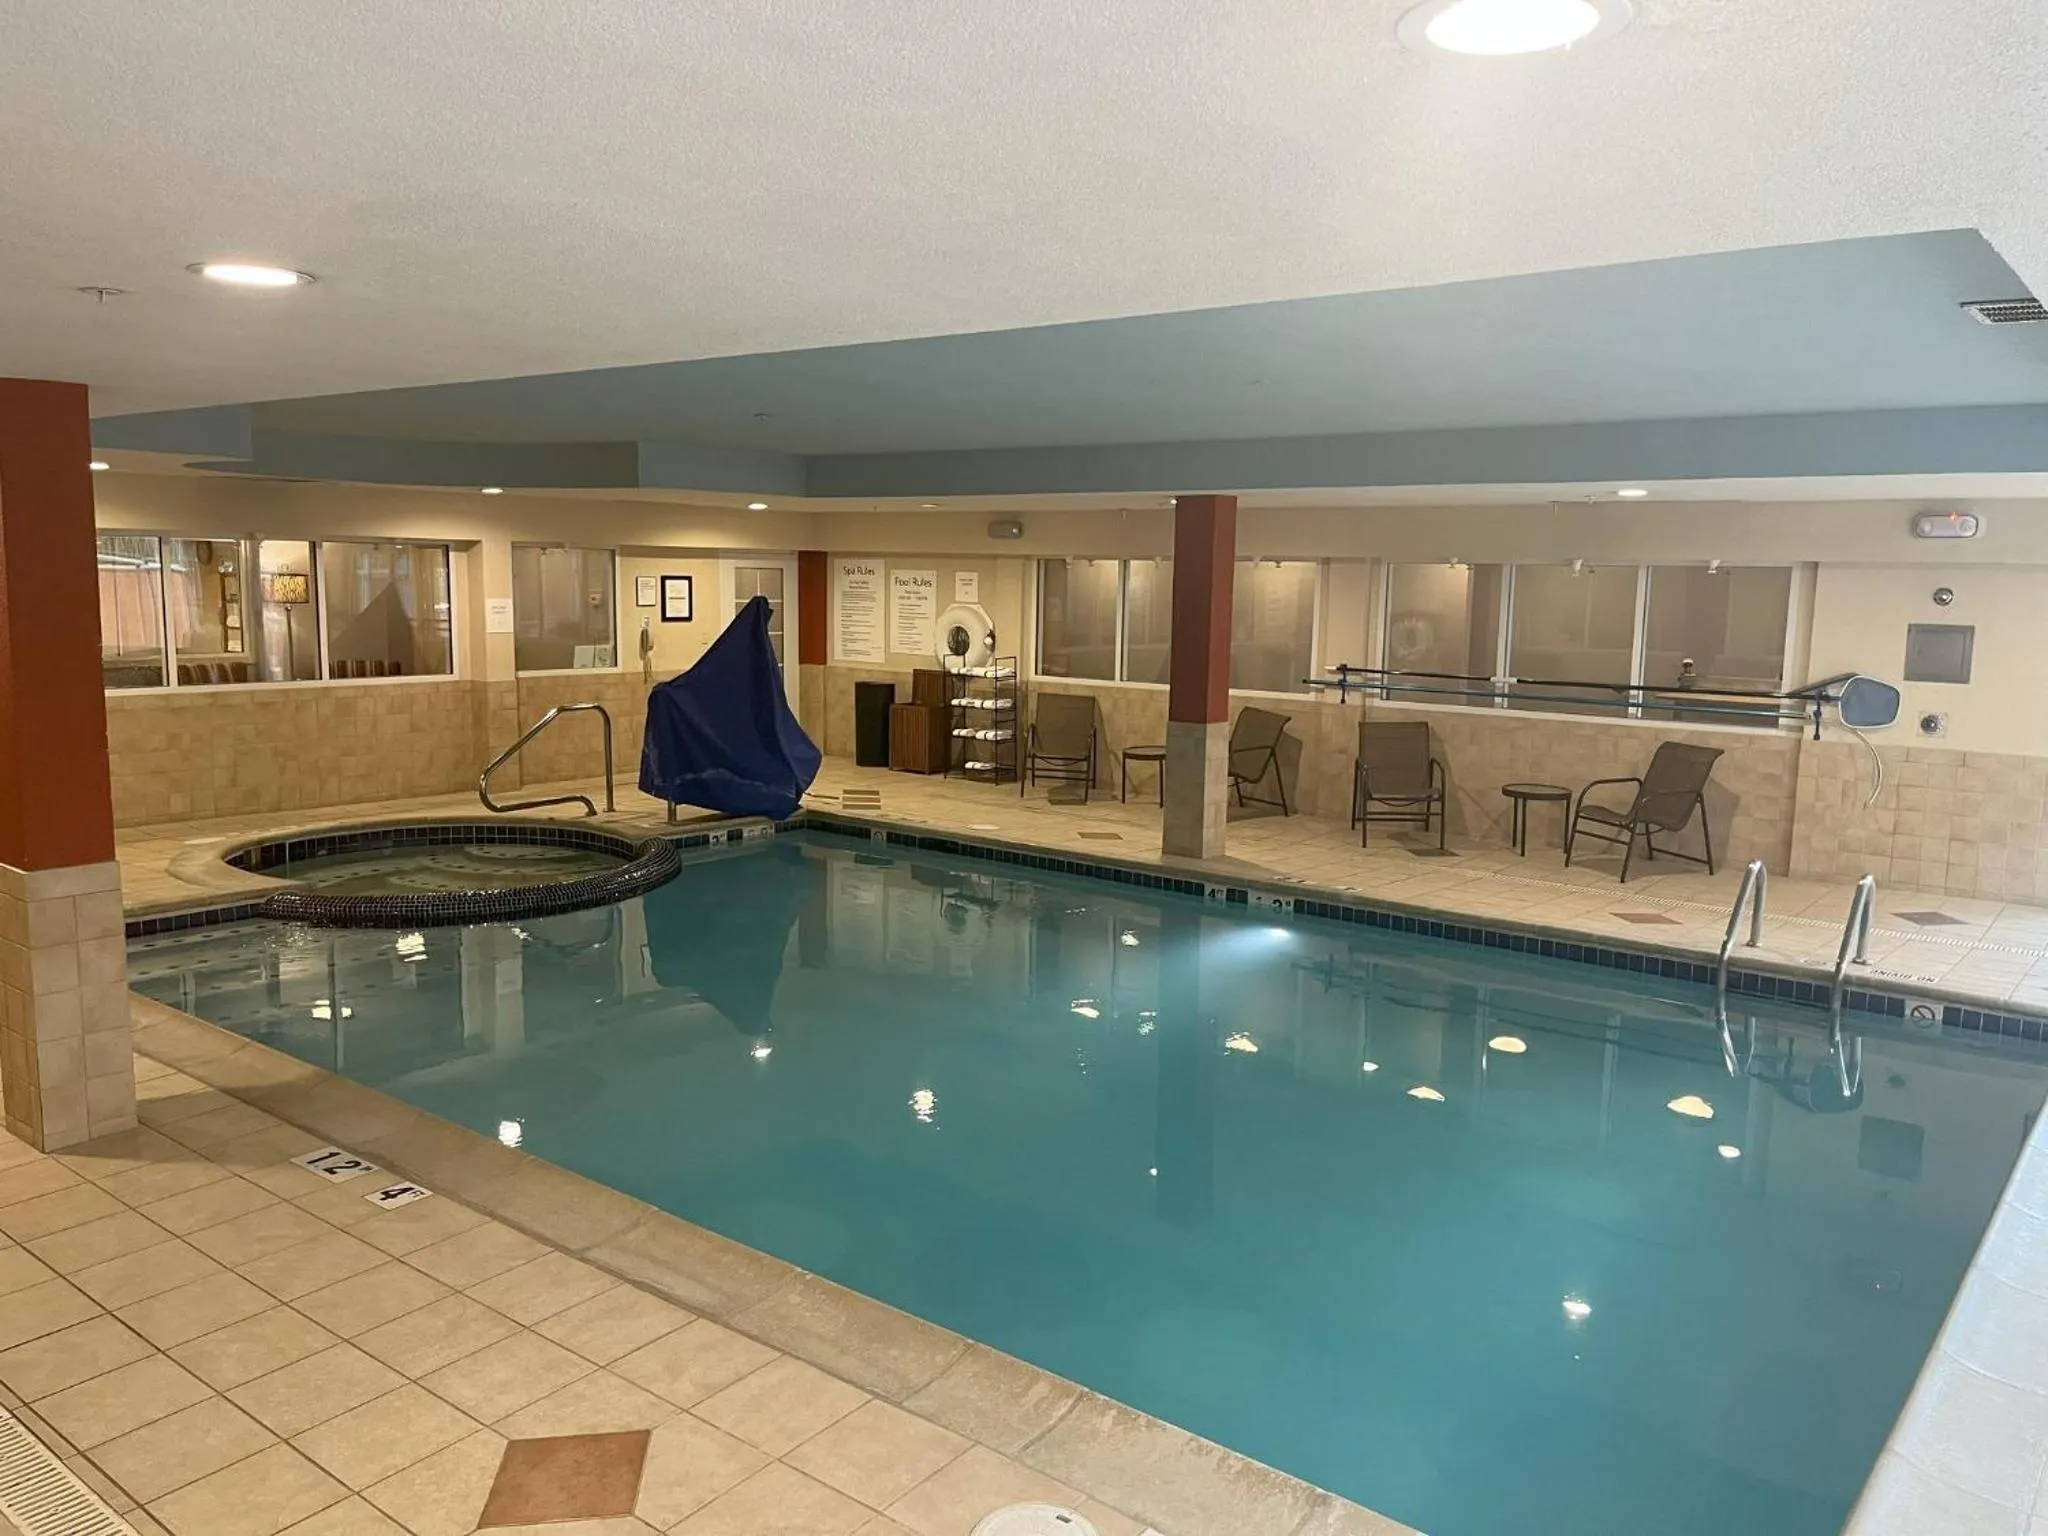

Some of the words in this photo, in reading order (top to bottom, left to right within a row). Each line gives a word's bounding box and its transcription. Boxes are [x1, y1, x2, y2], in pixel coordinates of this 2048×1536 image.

[842, 565, 855, 577] Spa
[857, 565, 875, 576] Rules
[894, 576, 910, 587] Pool
[912, 576, 932, 588] Rules
